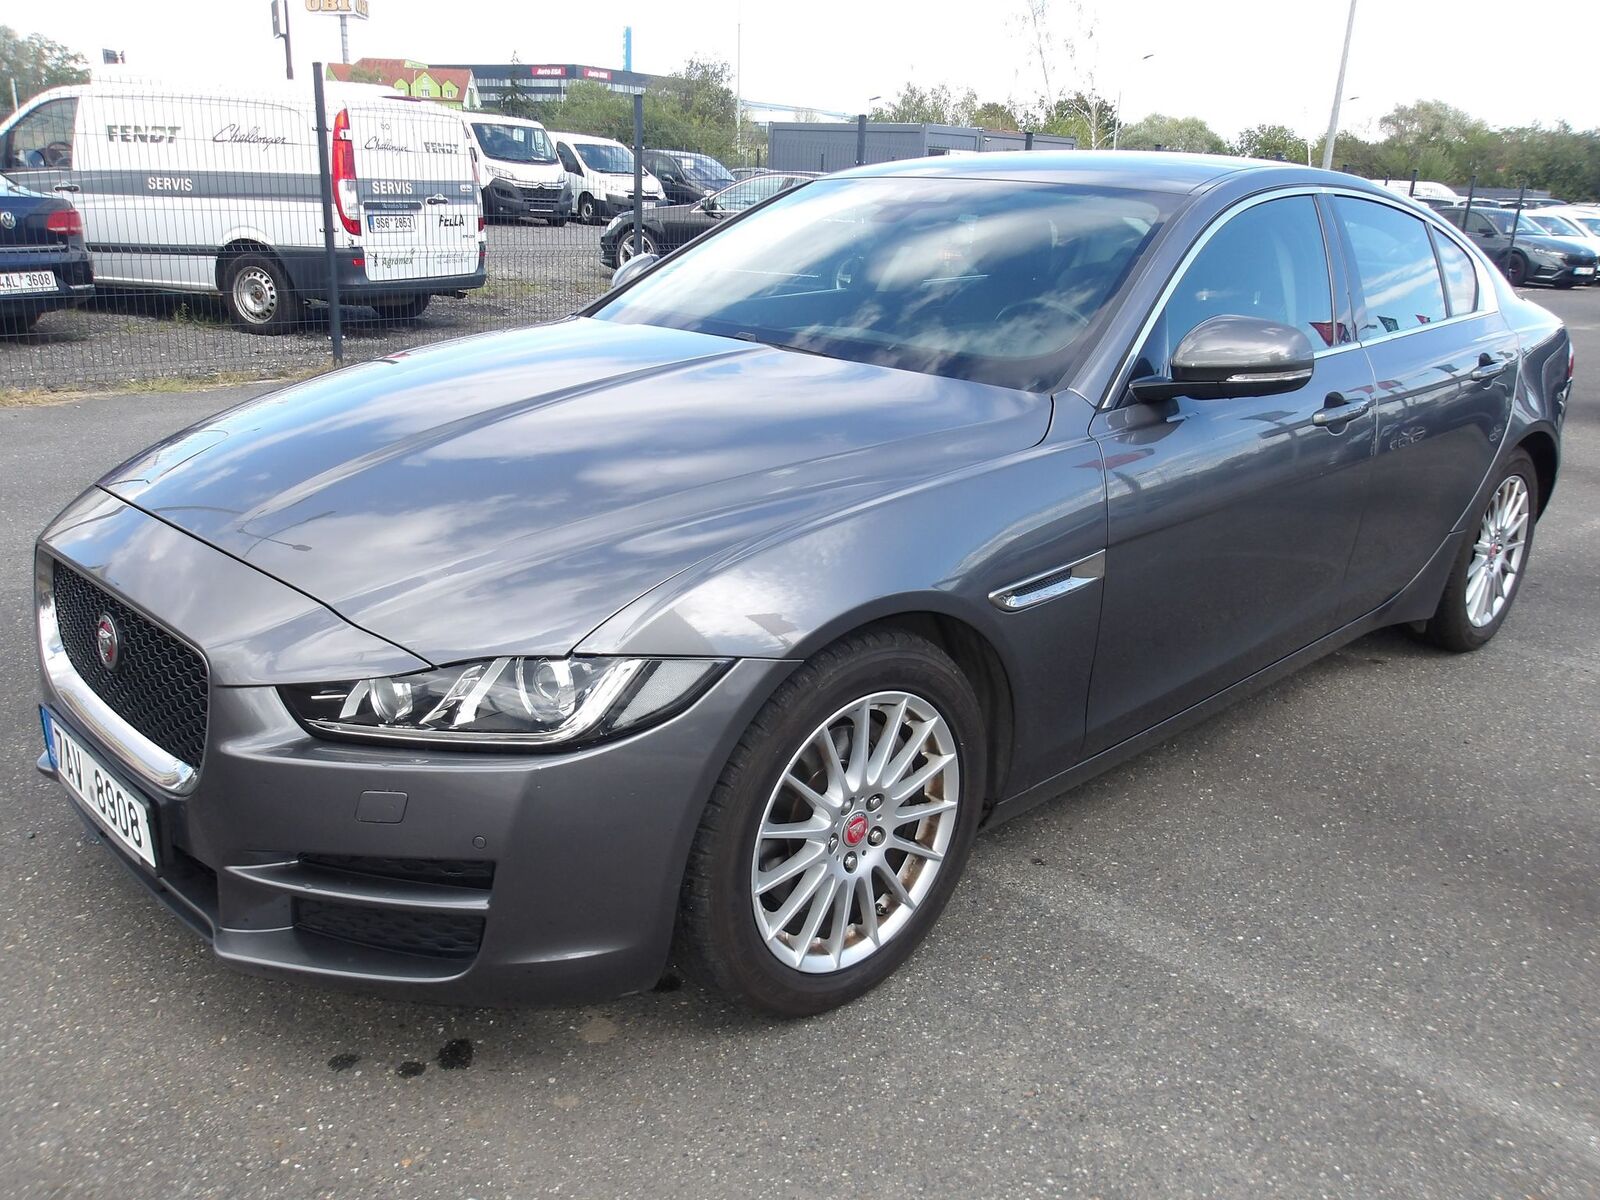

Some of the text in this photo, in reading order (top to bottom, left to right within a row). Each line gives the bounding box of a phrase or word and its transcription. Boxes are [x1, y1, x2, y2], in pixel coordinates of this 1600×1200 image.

[107, 125, 181, 144] FENDT
[212, 124, 298, 151] Challenger
[364, 136, 413, 156] Challenger
[424, 142, 459, 154] FENDT
[148, 177, 193, 191] SERVIS
[372, 181, 413, 194] SERVIS
[26, 273, 51, 287] 3608
[94, 768, 143, 849] 8908
